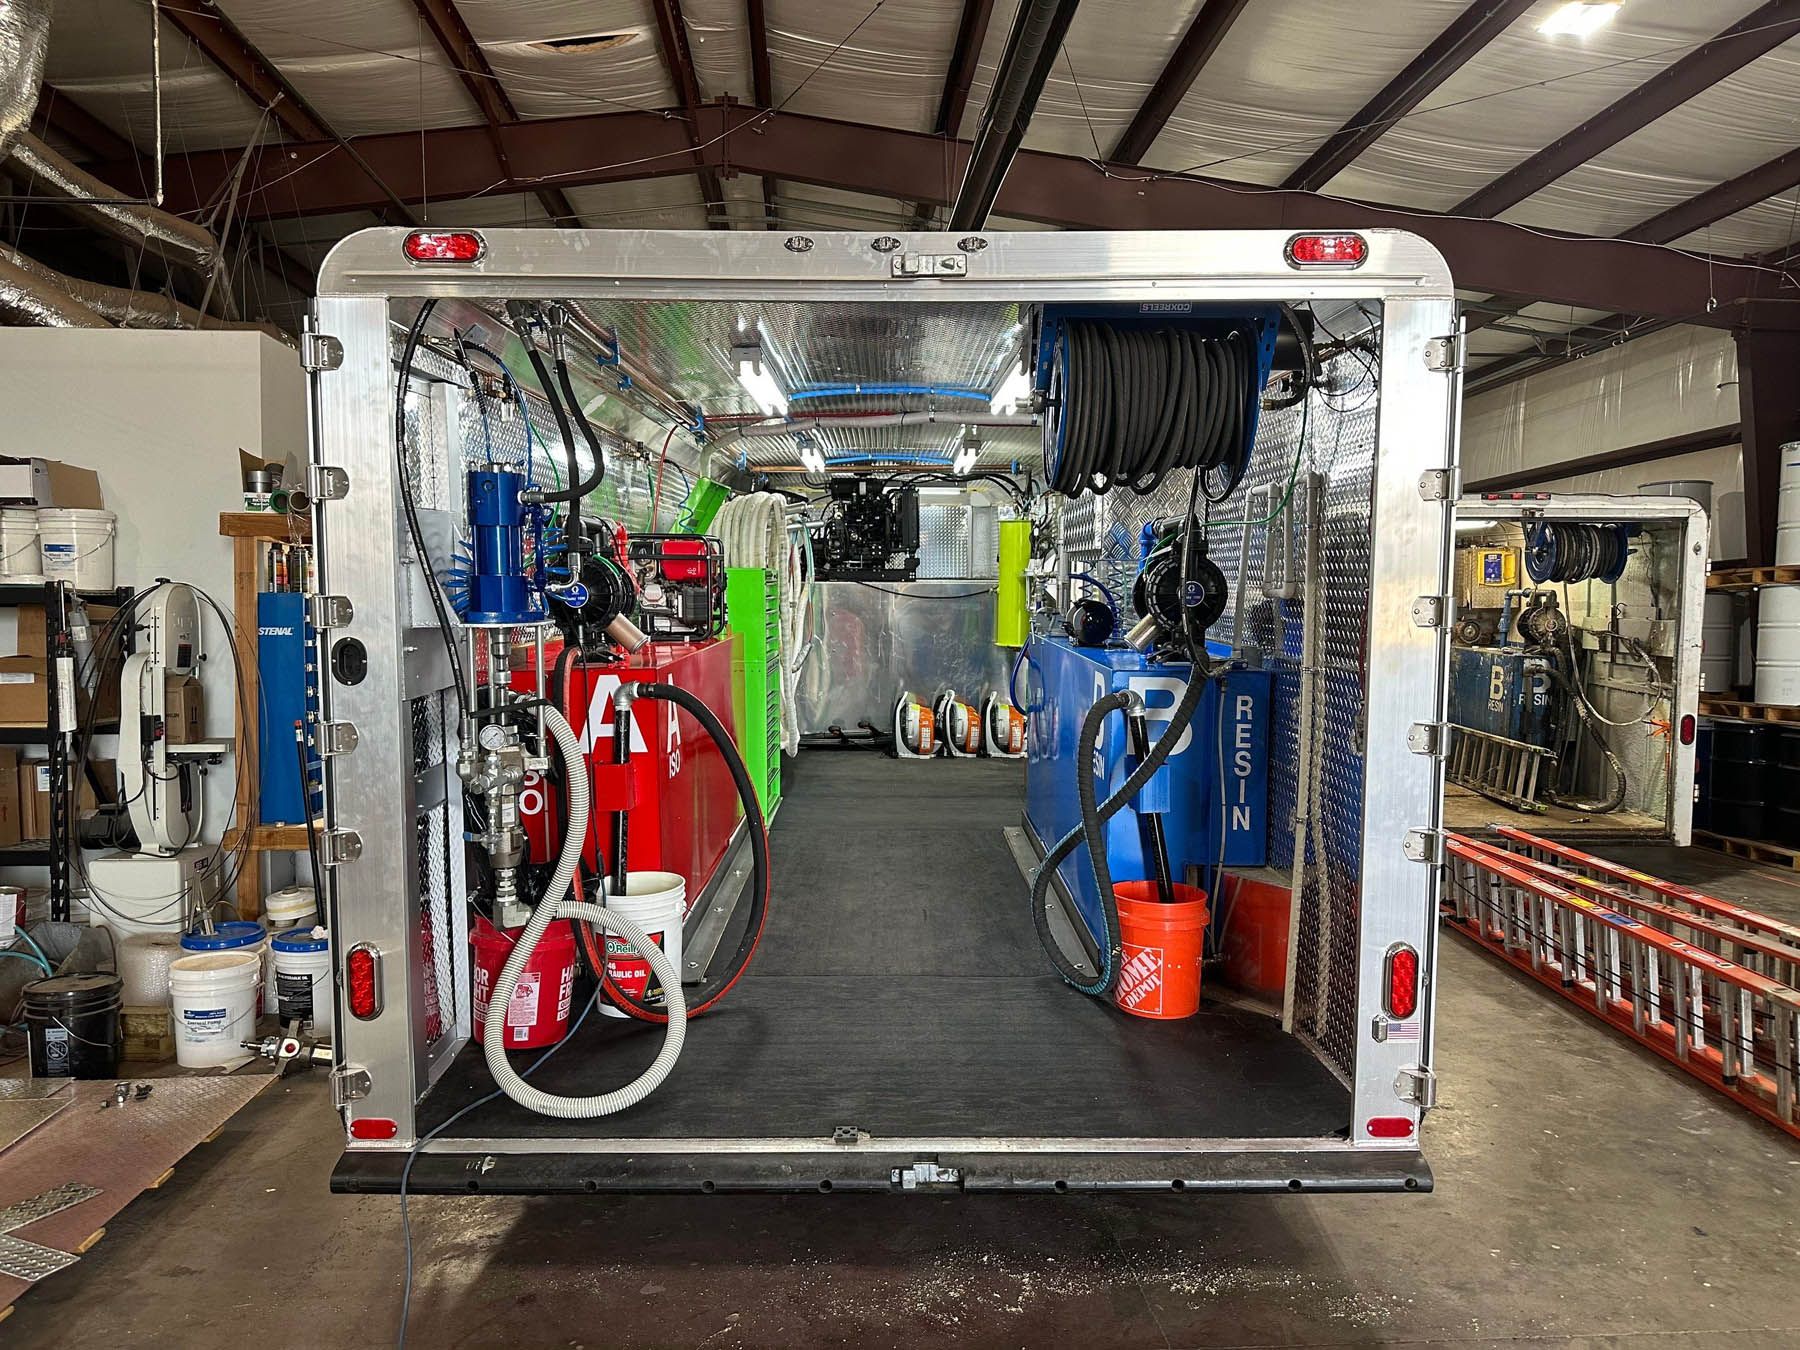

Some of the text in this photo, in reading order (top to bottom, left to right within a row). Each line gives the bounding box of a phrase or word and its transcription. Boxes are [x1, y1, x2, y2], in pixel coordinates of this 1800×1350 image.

[1142, 303, 1190, 311] COXREELS
[258, 627, 293, 636] STENAL
[1489, 665, 1504, 701] B
[1518, 693, 1553, 706] RSIN
[578, 674, 648, 753] A
[667, 673, 681, 755] A
[1127, 676, 1193, 756] B
[1487, 698, 1504, 713] RESIN
[668, 750, 681, 780] ISO
[1232, 695, 1254, 831] RESIN
[1115, 948, 1161, 1002] HOME
[1125, 972, 1161, 1008] DEPOT
